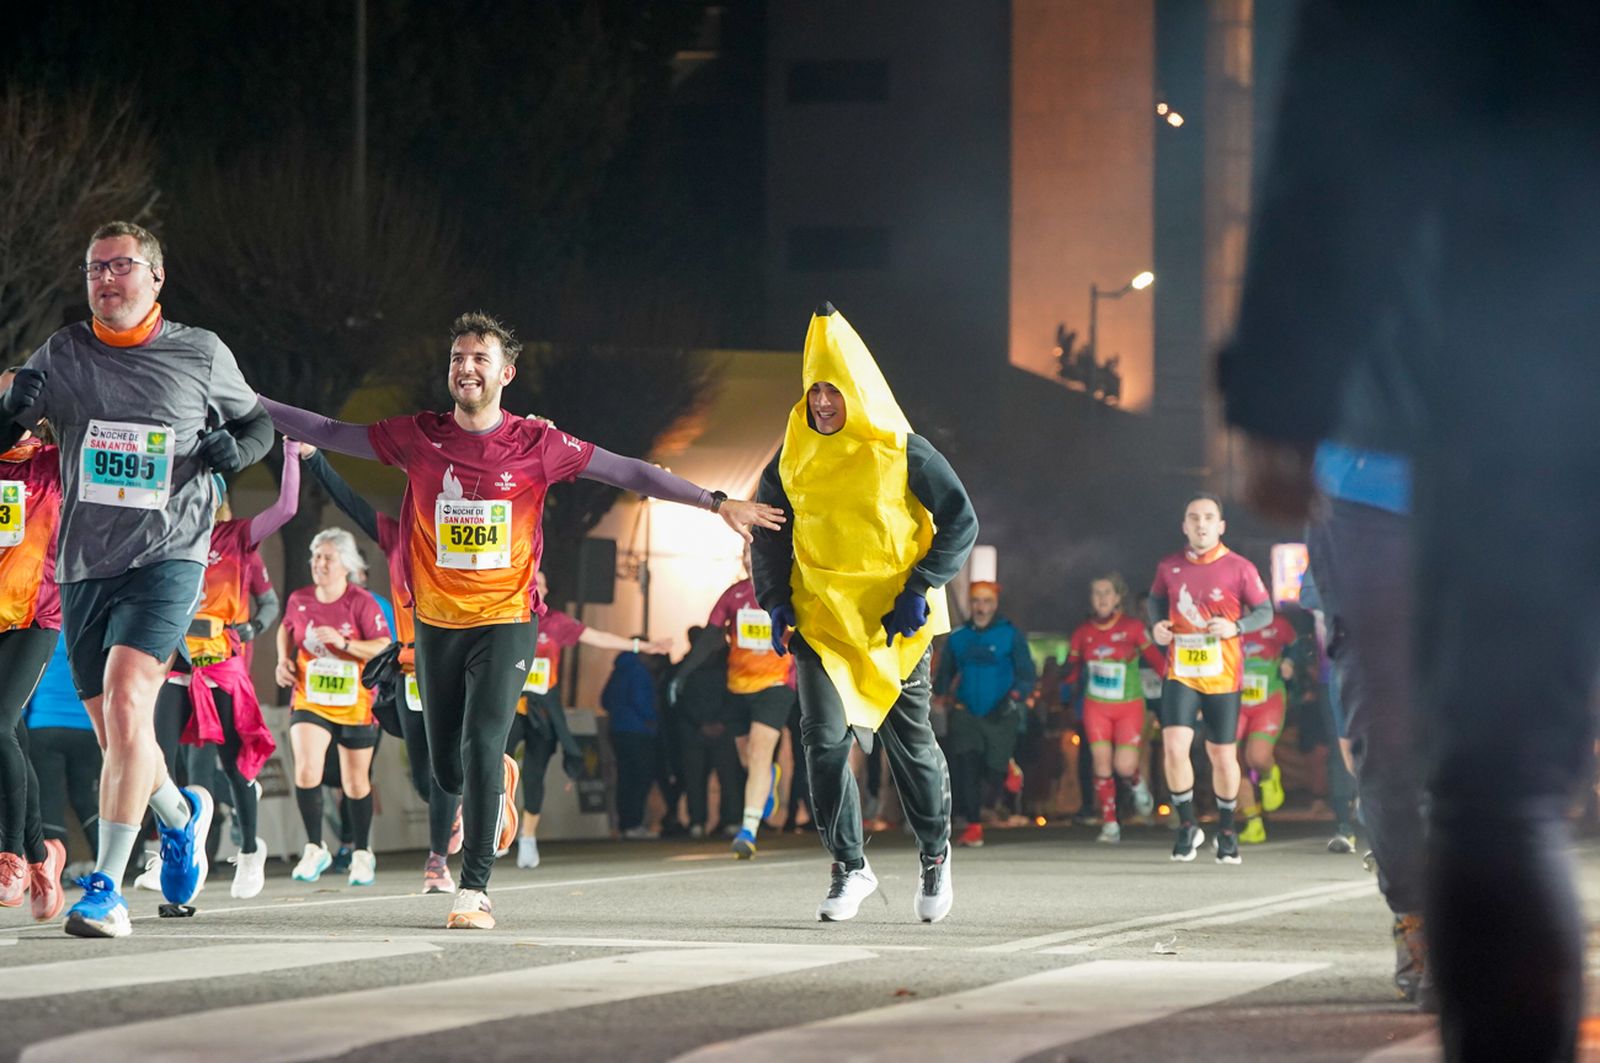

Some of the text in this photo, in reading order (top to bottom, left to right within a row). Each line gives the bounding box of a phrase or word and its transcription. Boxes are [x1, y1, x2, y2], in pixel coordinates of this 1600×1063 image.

[100, 431, 139, 441] NOCHE DE
[90, 439, 106, 449] SAN
[108, 441, 138, 452] ANTÓN
[95, 450, 155, 480] 9595
[444, 516, 459, 524] SAN
[460, 516, 485, 524] ANTÓN
[451, 525, 498, 546] 5264
[1187, 650, 1208, 661] 728
[318, 675, 345, 690] 7147
